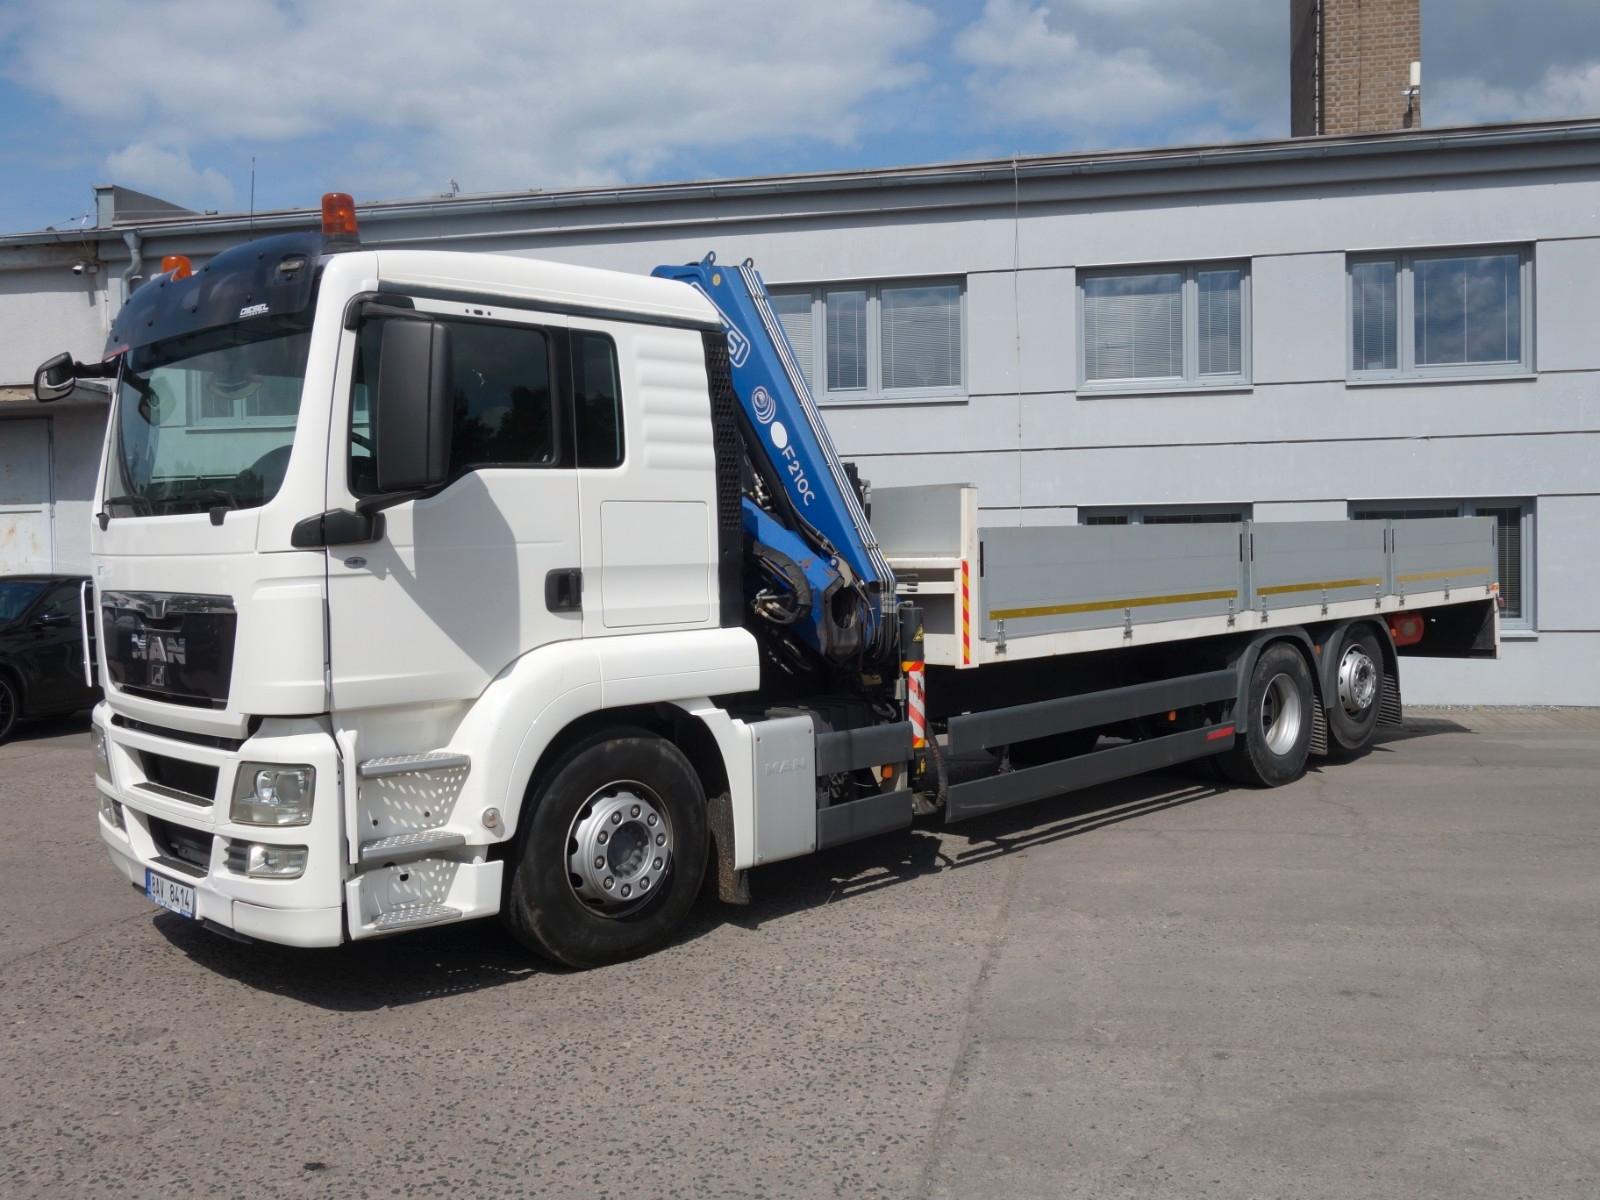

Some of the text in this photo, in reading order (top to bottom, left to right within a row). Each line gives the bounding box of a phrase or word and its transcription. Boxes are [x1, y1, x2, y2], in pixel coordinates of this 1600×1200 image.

[782, 445, 815, 506] F210C
[131, 633, 186, 665] MAN
[170, 883, 190, 909] 8414
